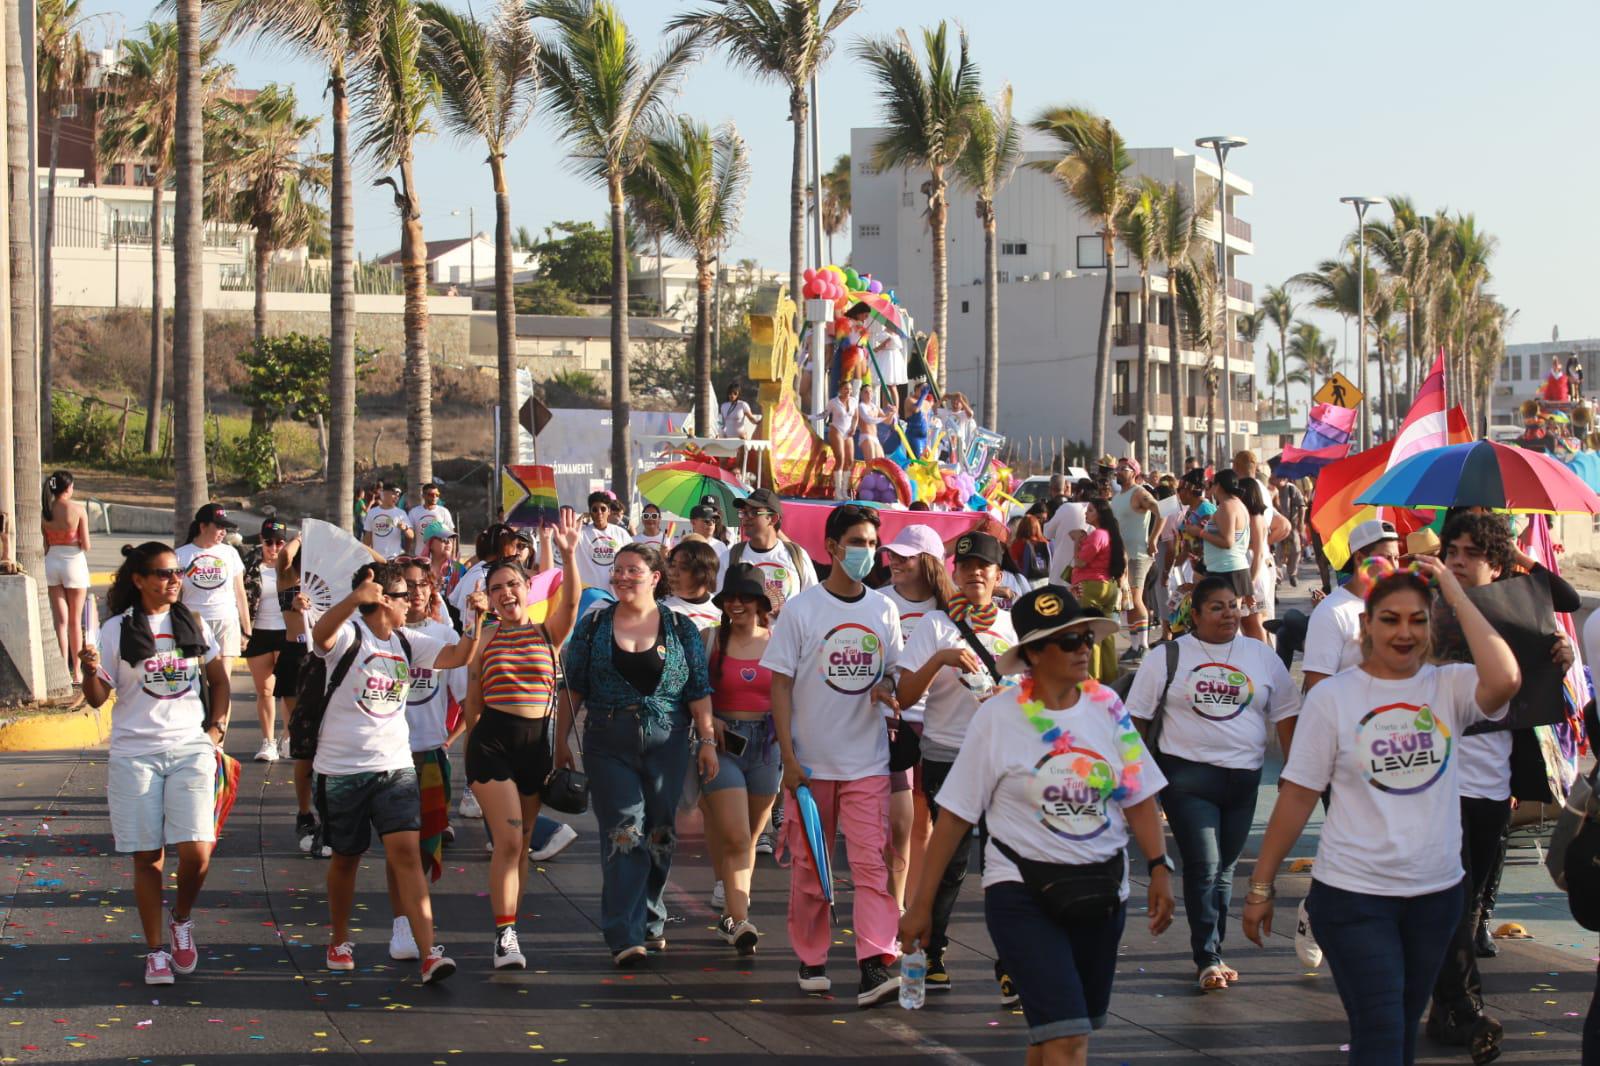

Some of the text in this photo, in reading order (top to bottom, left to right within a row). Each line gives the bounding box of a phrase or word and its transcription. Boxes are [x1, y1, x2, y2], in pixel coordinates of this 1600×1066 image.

[546, 460, 594, 475] ÓXIMAMENTE
[593, 546, 614, 554] CLUB
[194, 567, 222, 575] CLUB
[829, 652, 873, 666] CLUB
[828, 665, 875, 677] LEVEL
[1195, 680, 1240, 697] CLUB
[1194, 693, 1240, 706] LEVEL
[1371, 732, 1433, 757] CLUB
[1371, 750, 1441, 773] LEVEL
